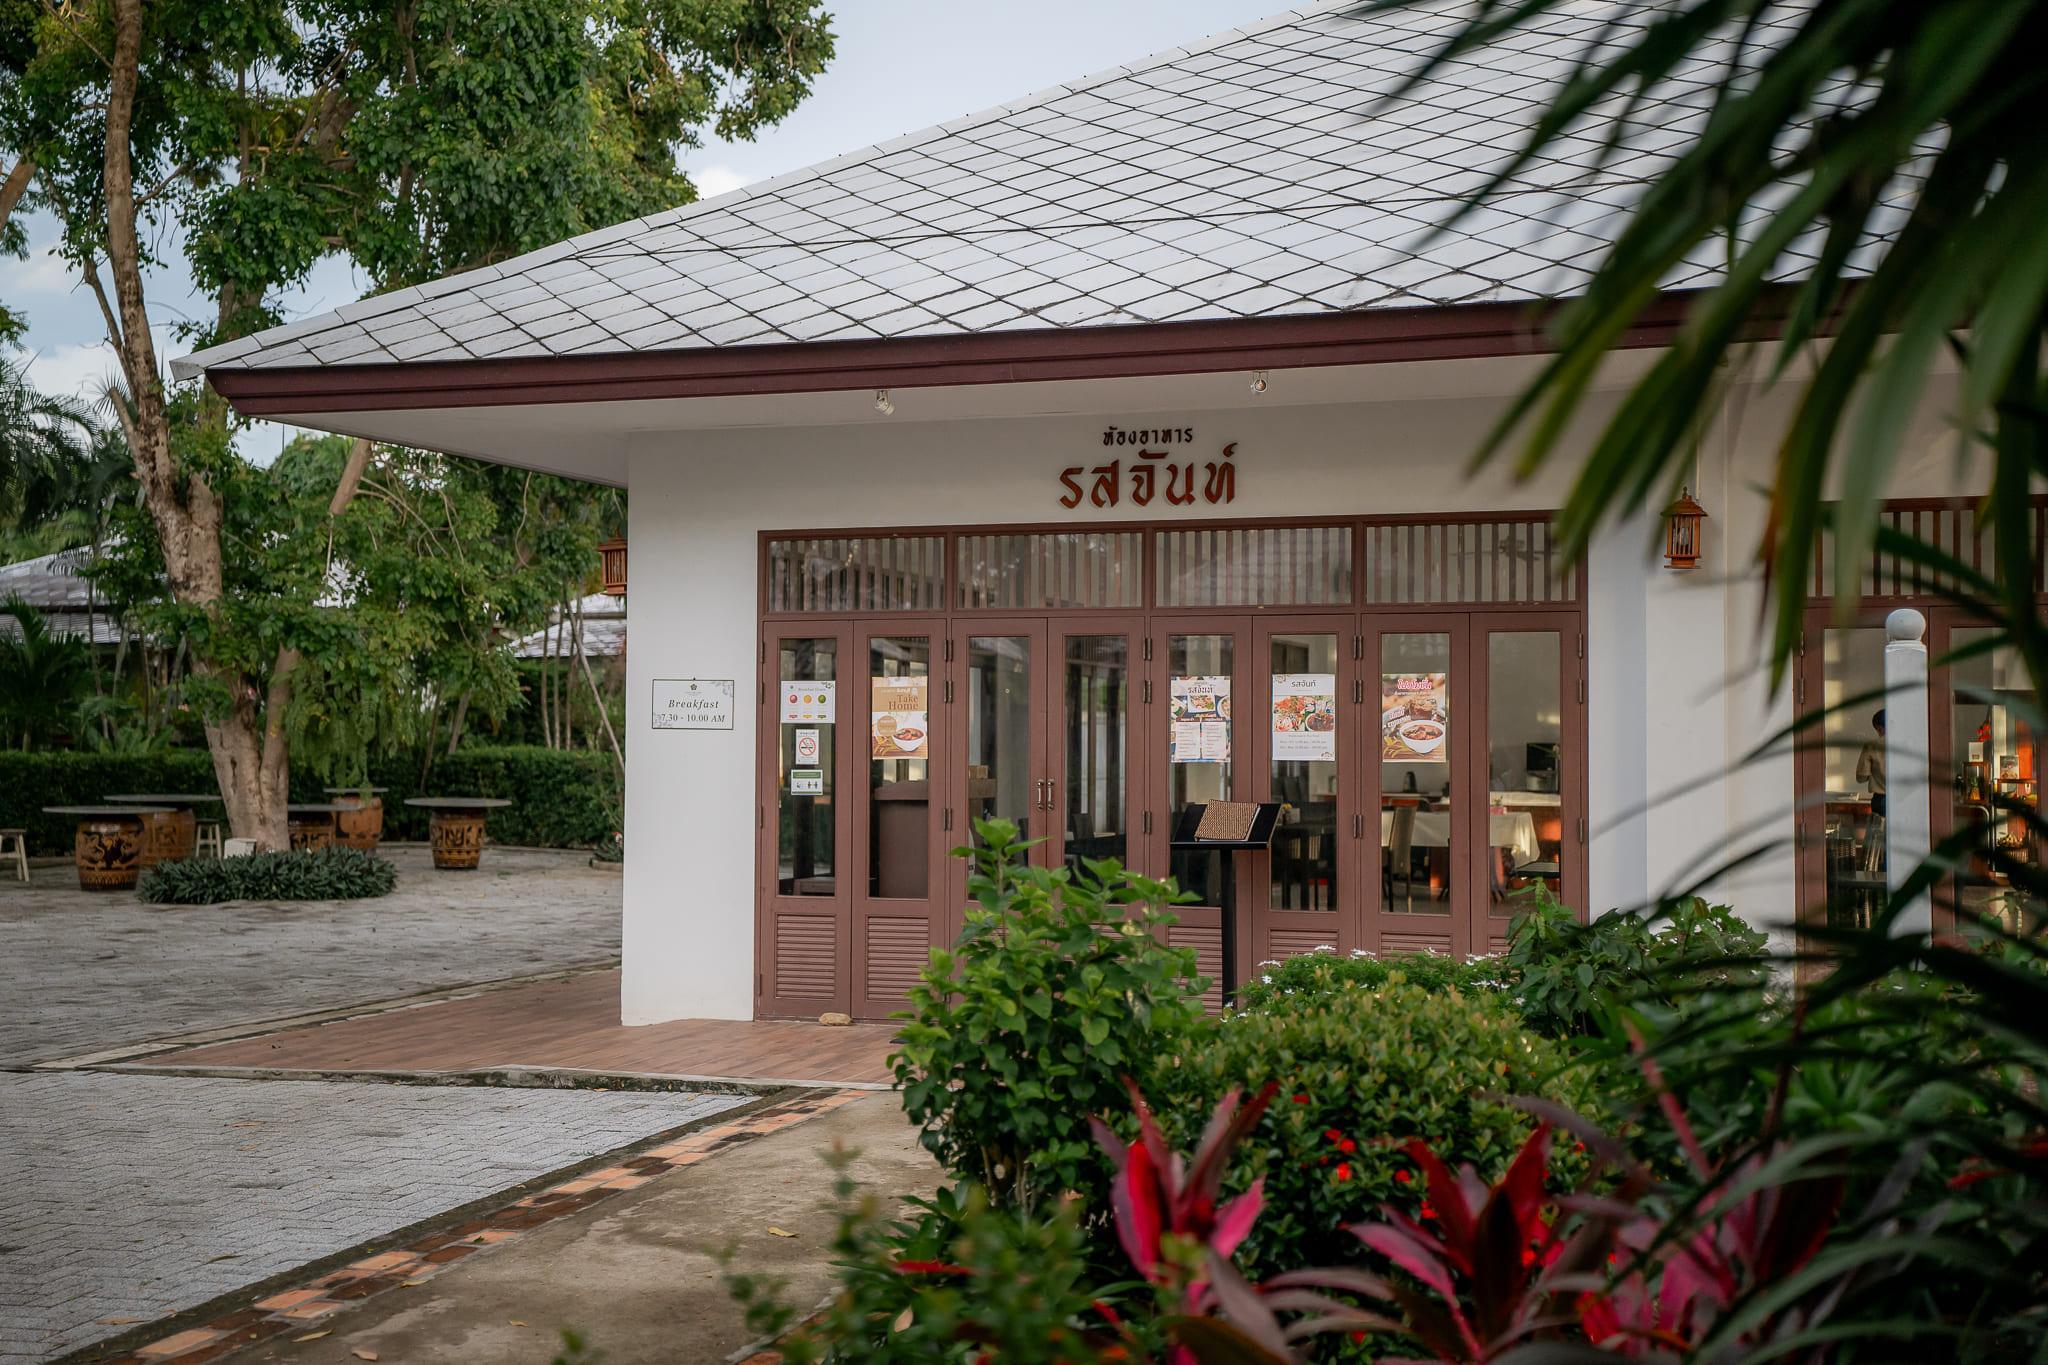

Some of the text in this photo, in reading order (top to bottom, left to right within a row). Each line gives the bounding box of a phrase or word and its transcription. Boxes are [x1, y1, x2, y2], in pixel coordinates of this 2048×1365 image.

[1102, 425, 1193, 446] ห้องอาหาร
[1059, 442, 1239, 510] รสจันท์
[897, 694, 919, 703] Take
[668, 699, 719, 710] Breakfast
[888, 701, 919, 710] Home
[687, 714, 709, 722] 10.00
[711, 714, 726, 722] AM
